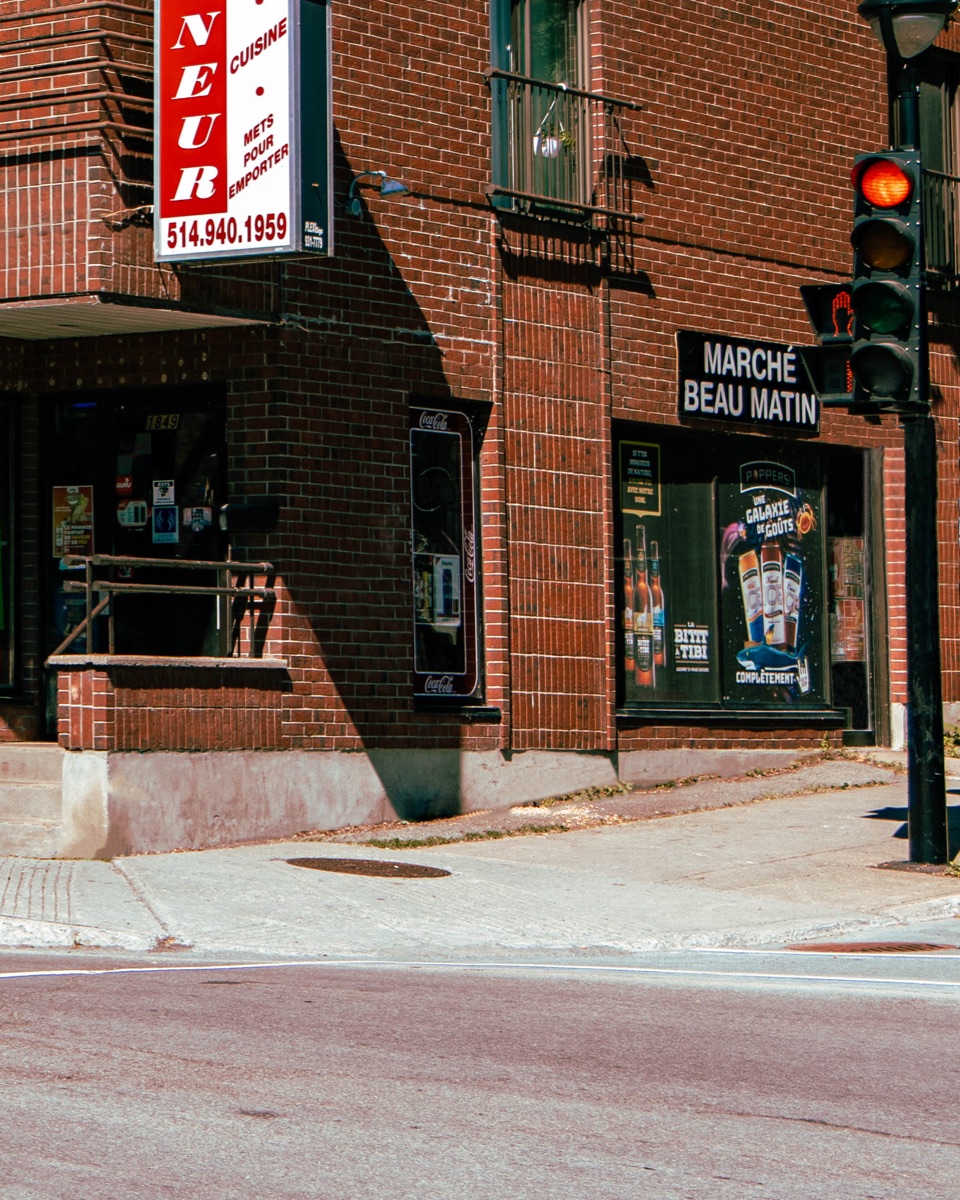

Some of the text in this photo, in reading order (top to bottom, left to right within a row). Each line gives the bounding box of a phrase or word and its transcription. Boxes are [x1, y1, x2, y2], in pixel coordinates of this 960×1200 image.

[230, 17, 288, 75] CUISINE
[243, 113, 274, 147] METS
[243, 134, 274, 168] POUR
[228, 143, 289, 200] EMPORTER
[167, 212, 287, 249] 514.940.1959
[703, 340, 798, 384] MARCHÉ
[684, 378, 817, 425] BEAU MATIN
[149, 415, 178, 429] 1849
[419, 411, 449, 431] Coca-Cola
[746, 468, 790, 486] POPPERS
[745, 499, 790, 525] GALAXIE
[752, 494, 766, 506] UNE
[756, 517, 794, 539] DE GOÛTS
[680, 645, 709, 660] TIBI
[424, 675, 455, 694] Coca-Cola
[735, 669, 795, 685] COMPLÈTEMENT
